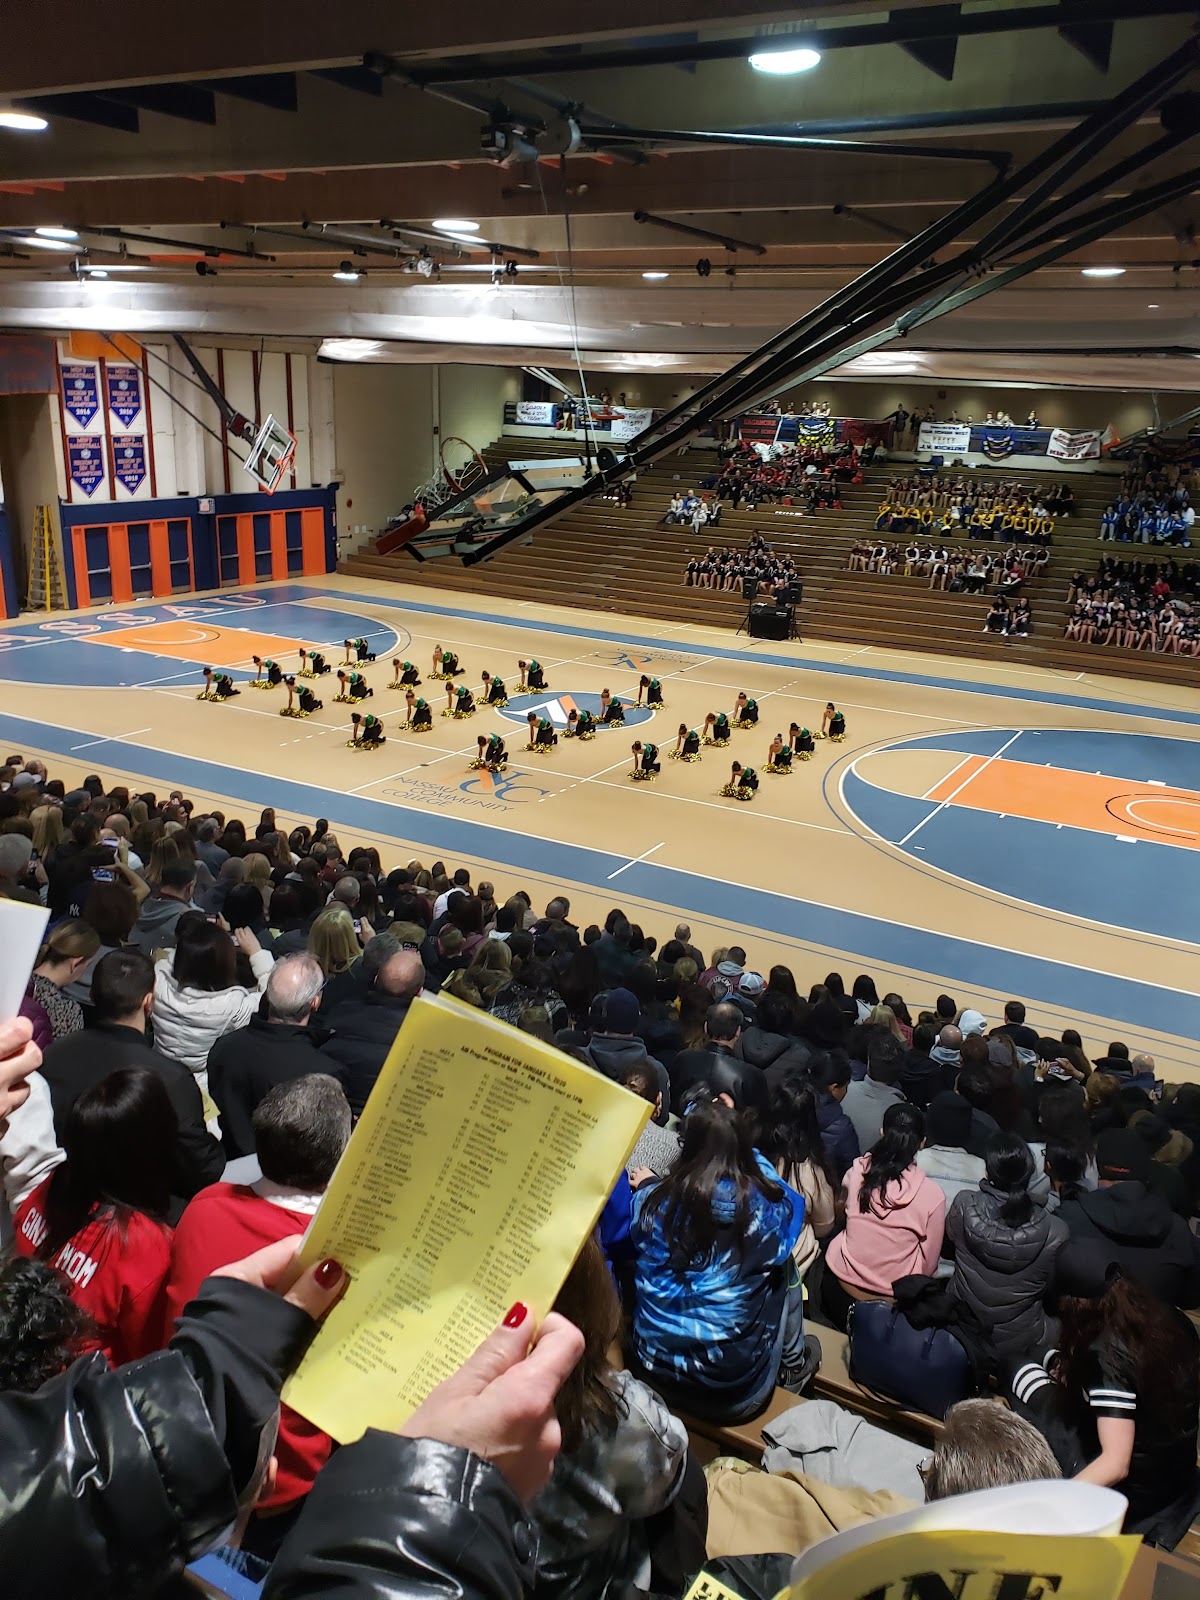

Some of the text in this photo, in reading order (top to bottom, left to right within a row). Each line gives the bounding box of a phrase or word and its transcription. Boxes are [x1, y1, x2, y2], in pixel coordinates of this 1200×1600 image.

[381, 788, 453, 807] COLLEGE
[396, 776, 458, 794] NASSAU
[409, 787, 514, 812] COMMUNITY
[469, 1048, 489, 1062] Program
[535, 1077, 555, 1091] Program
[571, 1095, 583, 1104] 1PM
[483, 1046, 511, 1062] PROGRAM
[510, 1057, 522, 1067] FOR
[522, 1062, 546, 1077] JANUARY
[552, 1076, 567, 1087] 2020
[54, 1242, 99, 1289] MOM
